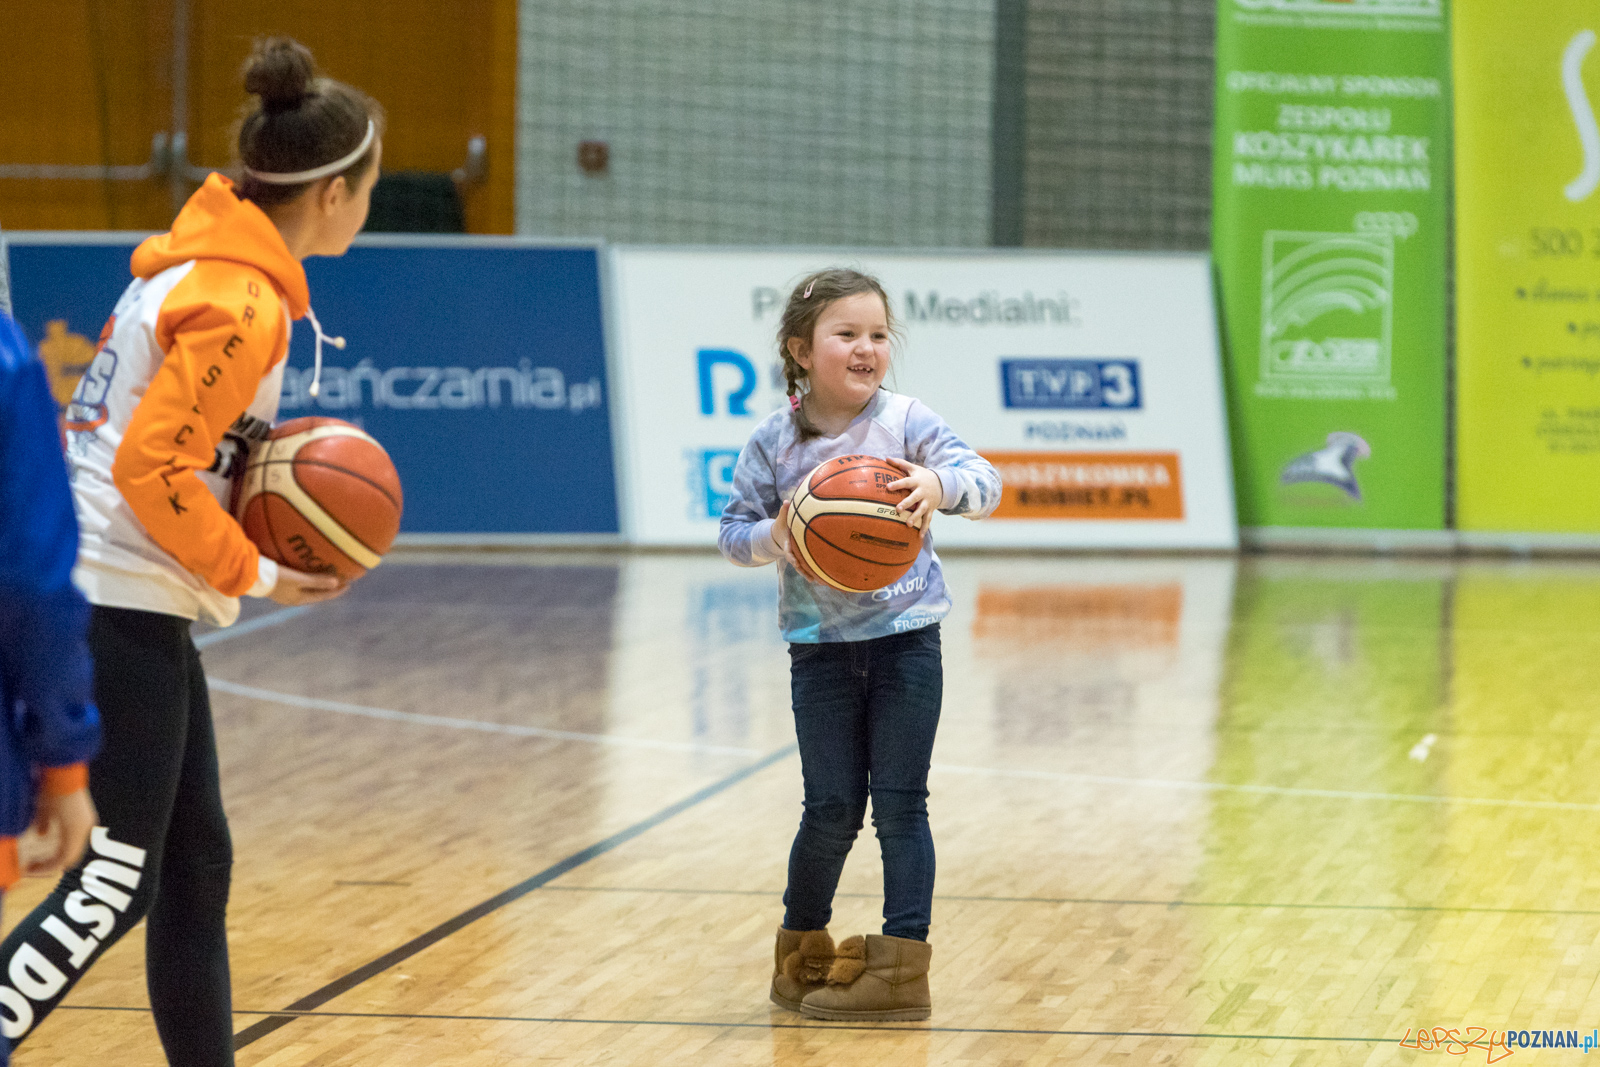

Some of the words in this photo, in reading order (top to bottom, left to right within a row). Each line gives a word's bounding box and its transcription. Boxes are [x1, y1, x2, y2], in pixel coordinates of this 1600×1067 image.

[893, 615, 939, 632] FROZEN
[40, 826, 147, 970] JUST
[0, 942, 69, 1039] DO
